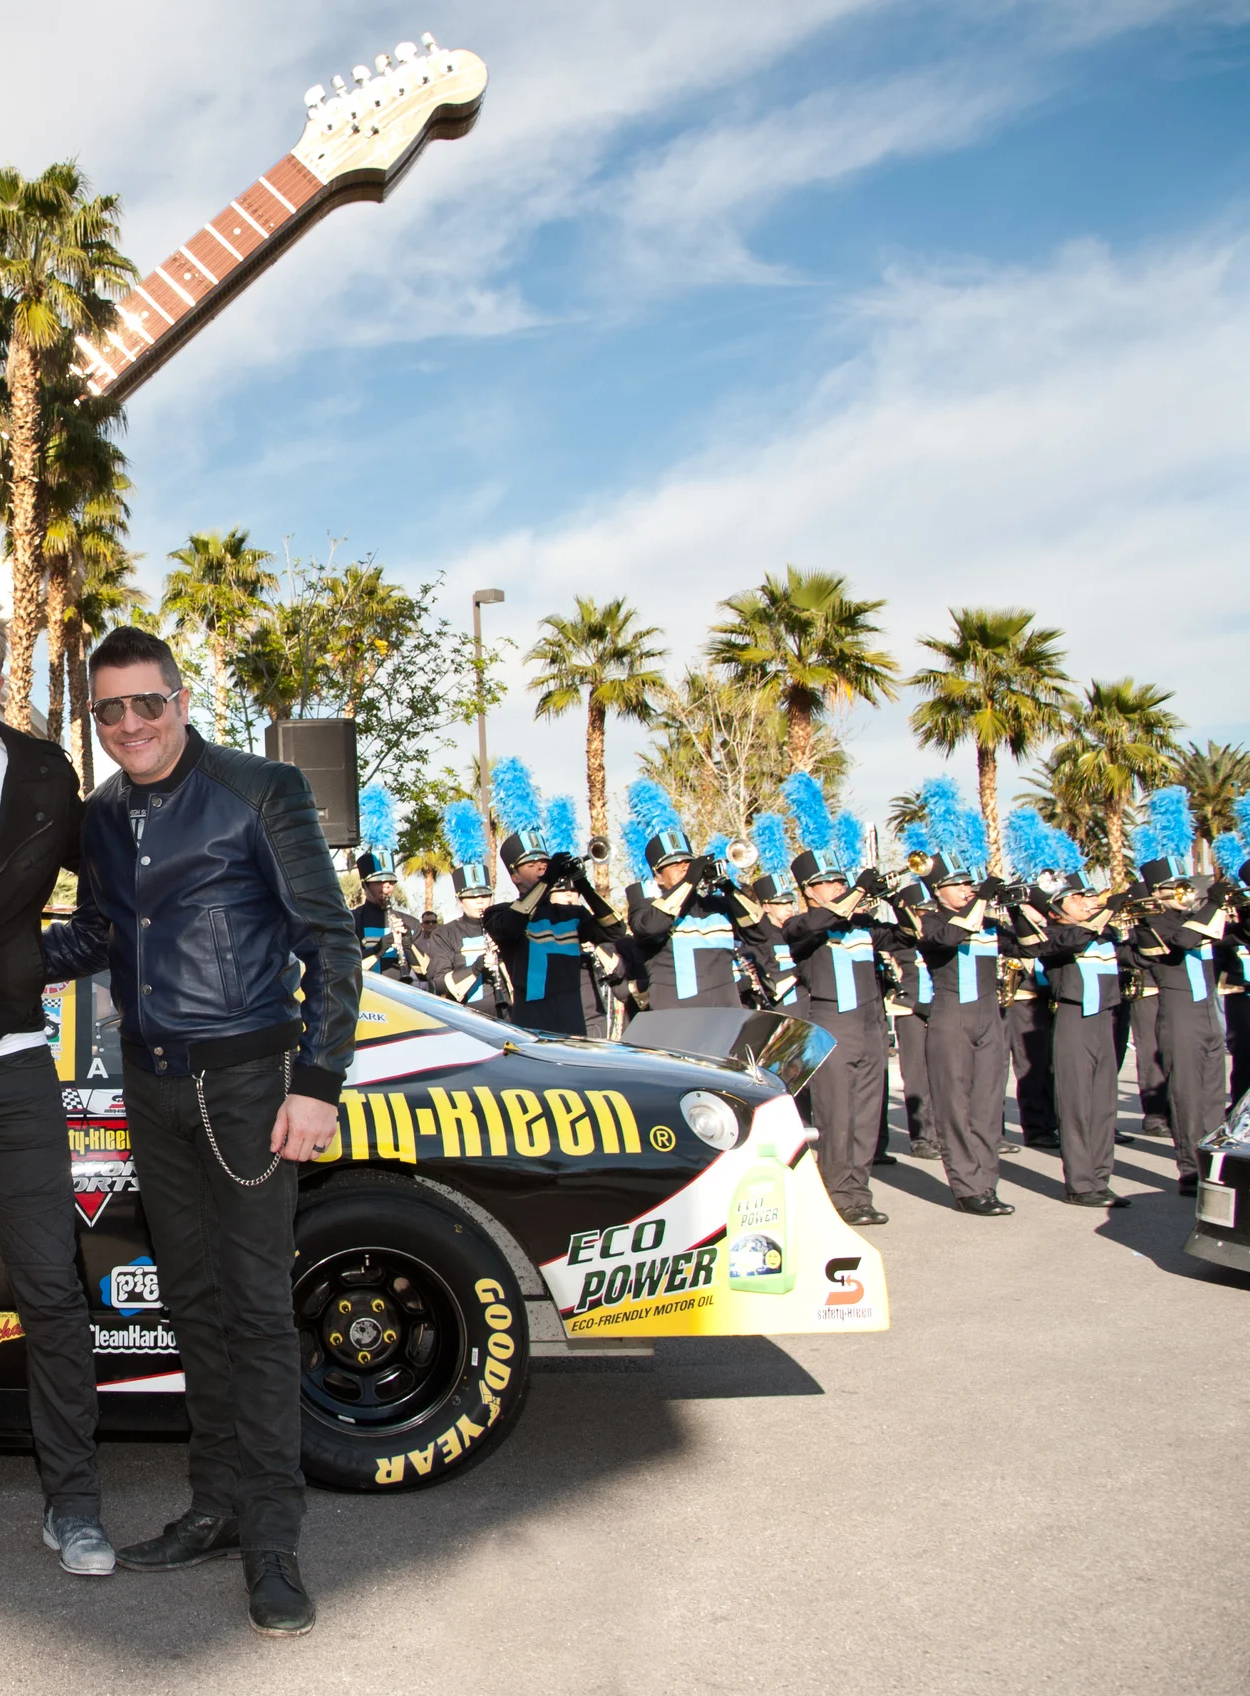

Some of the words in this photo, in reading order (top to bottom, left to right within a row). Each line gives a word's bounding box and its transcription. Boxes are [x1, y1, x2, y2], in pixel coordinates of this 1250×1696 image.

[567, 1218, 666, 1267] ECO
[574, 1246, 719, 1313] POWER
[571, 1308, 650, 1332] ECO-FRIENDLY
[654, 1299, 696, 1315] MOTOR
[697, 1295, 714, 1308] OIL
[817, 1307, 872, 1321] safety-kleen
